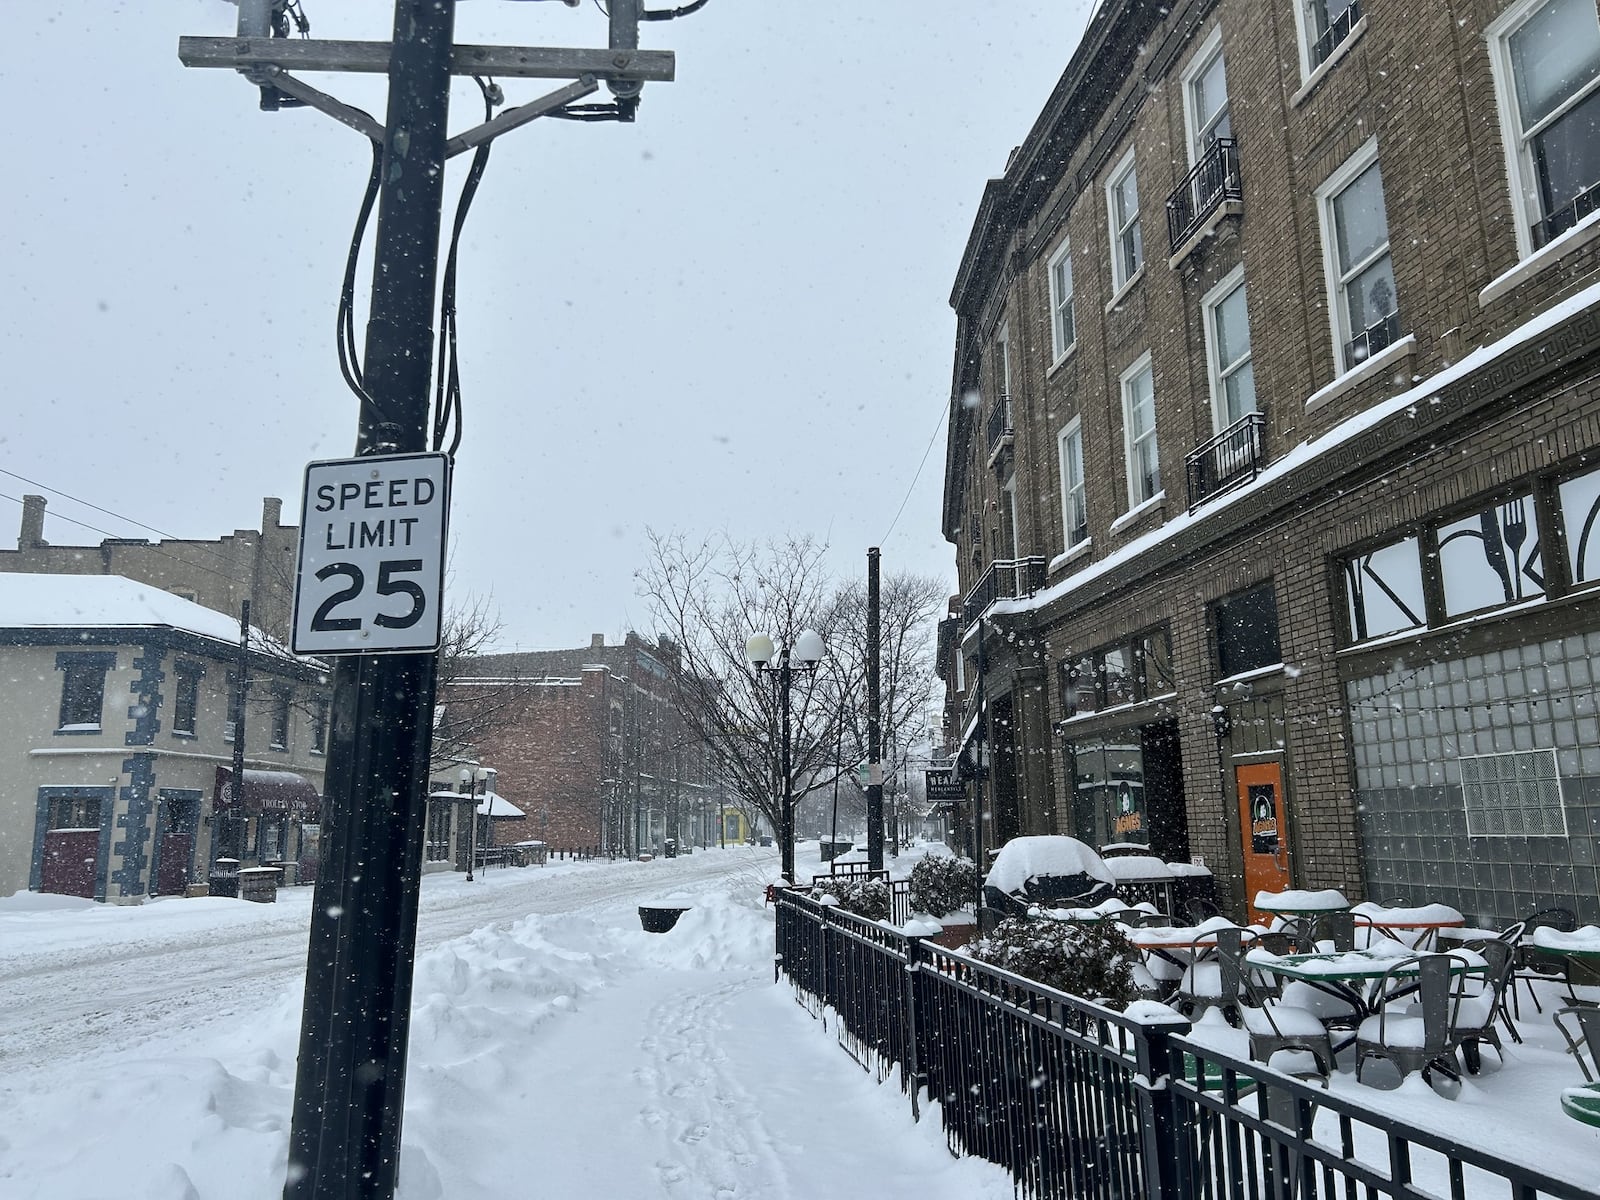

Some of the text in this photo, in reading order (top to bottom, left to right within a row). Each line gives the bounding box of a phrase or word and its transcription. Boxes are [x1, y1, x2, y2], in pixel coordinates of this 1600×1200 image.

[315, 478, 435, 512] SPEED
[326, 517, 419, 550] LIMIT
[311, 559, 426, 632] 25
[930, 776, 960, 785] HEA
